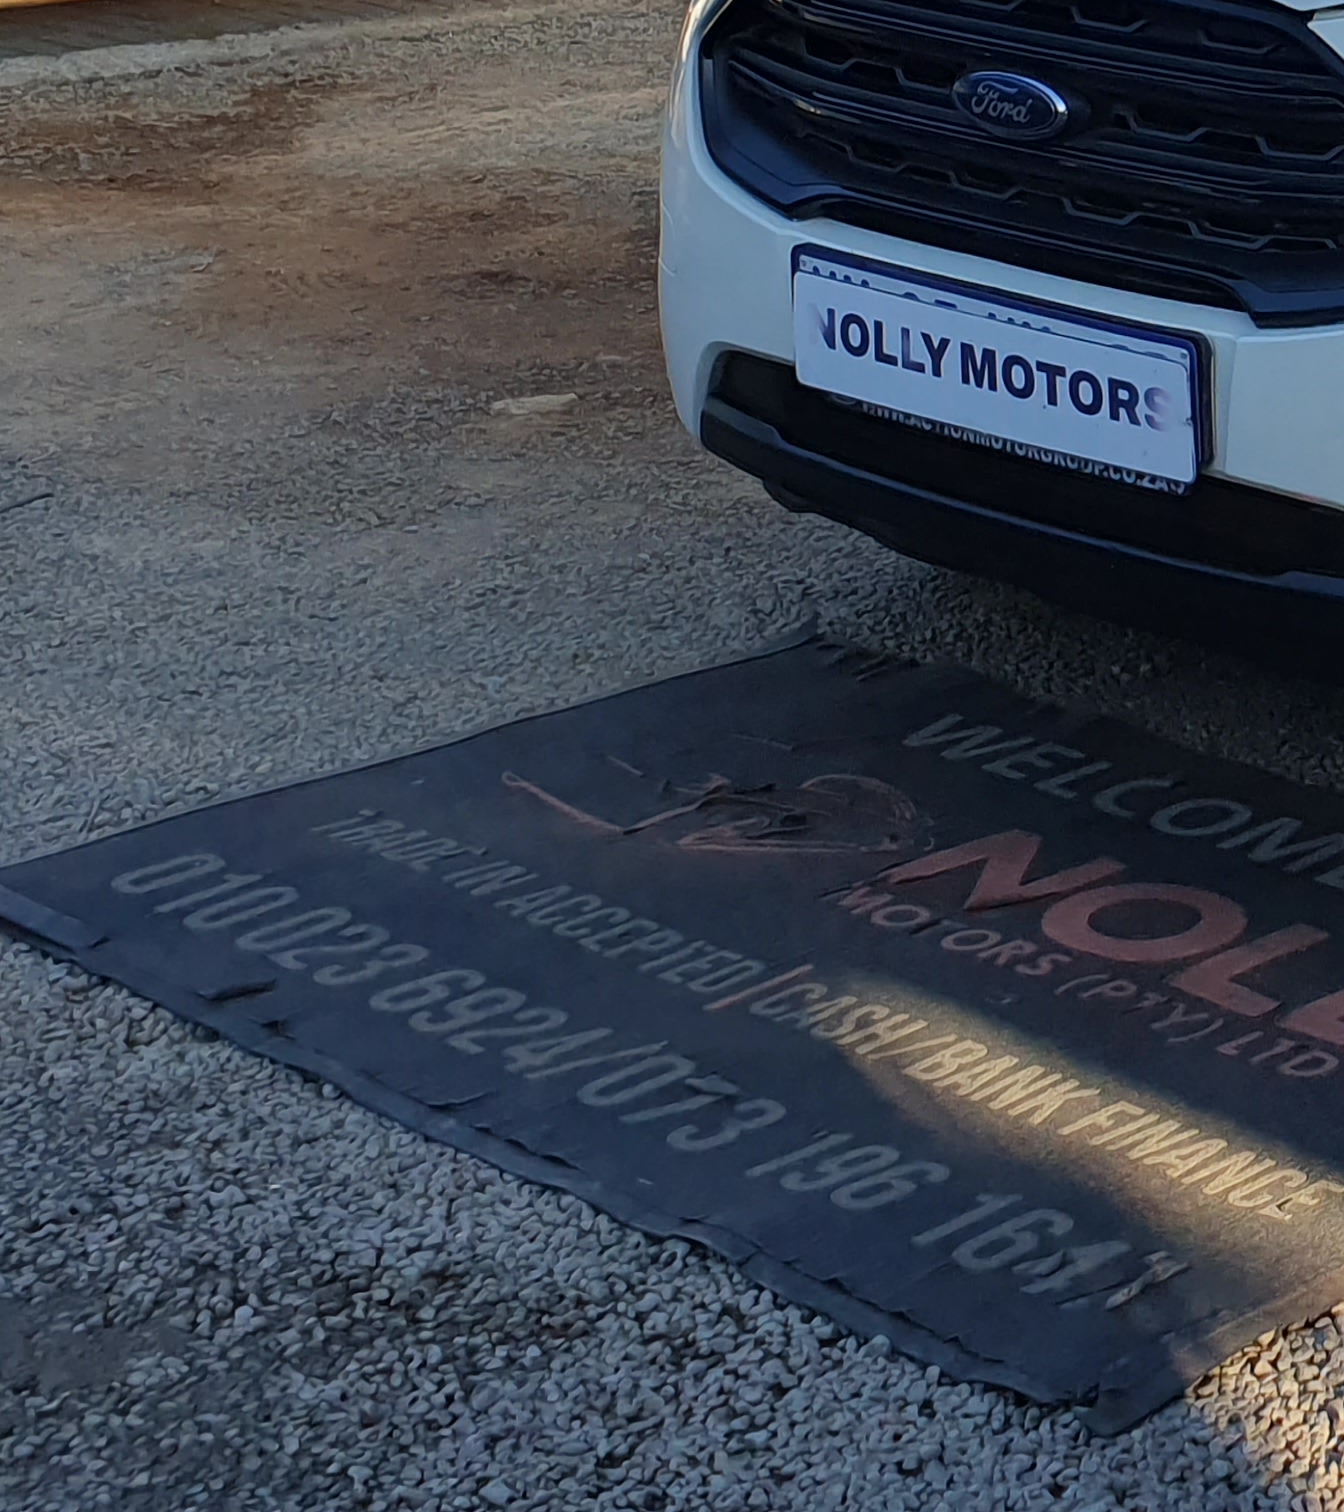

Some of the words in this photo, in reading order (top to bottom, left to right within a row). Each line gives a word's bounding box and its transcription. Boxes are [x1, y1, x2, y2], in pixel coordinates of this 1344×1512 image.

[972, 81, 1034, 123] Ford
[810, 303, 951, 378] NOLLY
[960, 341, 1173, 432] MOTORS
[442, 859, 538, 896] IN
[838, 886, 1072, 976] MOTORS
[1216, 1031, 1340, 1078] LTD
[745, 1131, 950, 1210] 196
[909, 1193, 1189, 1311] 164
